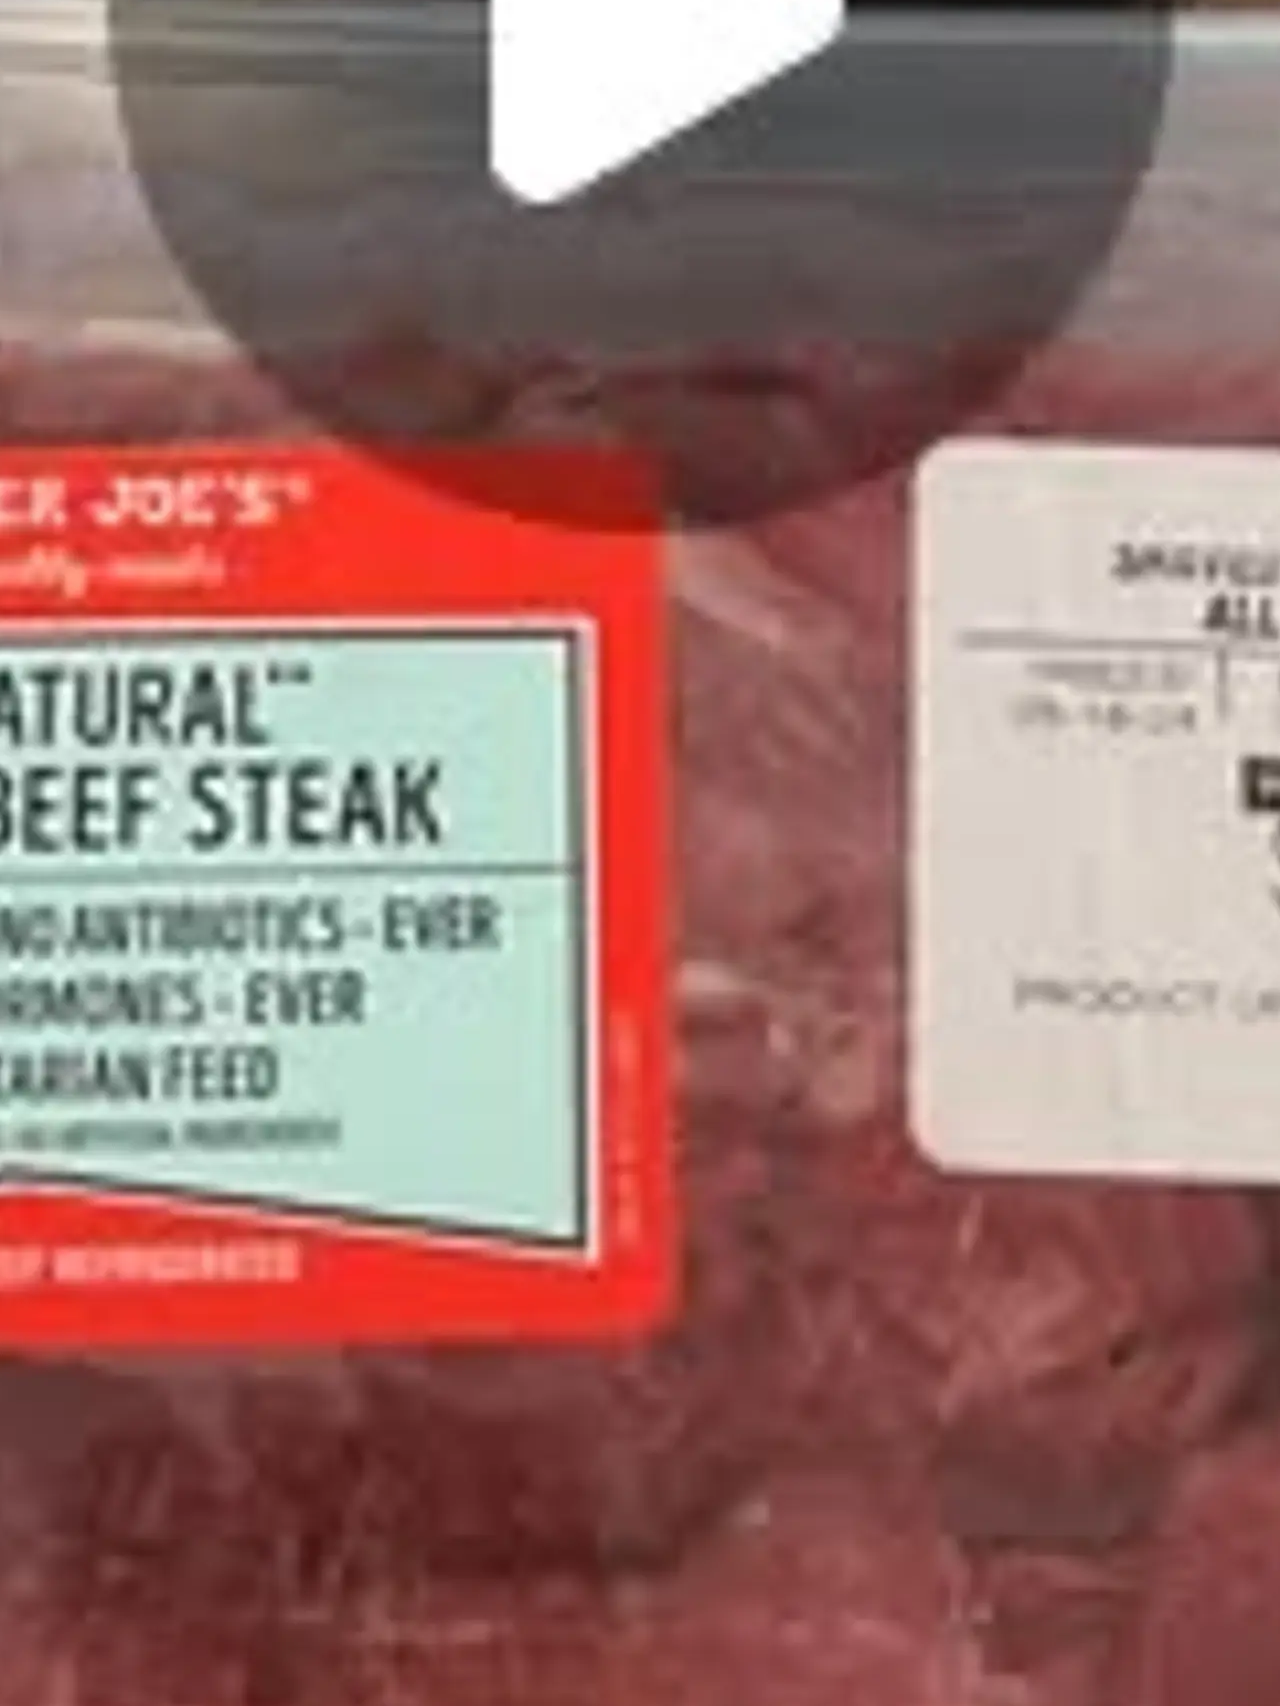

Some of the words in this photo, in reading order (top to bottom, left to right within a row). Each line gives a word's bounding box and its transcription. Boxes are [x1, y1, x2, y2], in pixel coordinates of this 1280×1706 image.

[1205, 593, 1280, 640] ALL
[186, 757, 442, 851] STEAK
[65, 897, 344, 954] ANTIBIOTICS
[383, 895, 501, 955] EVER
[245, 970, 366, 1026] EVER
[1014, 978, 1218, 1016] PRODUCT
[160, 1041, 280, 1101] FEED
